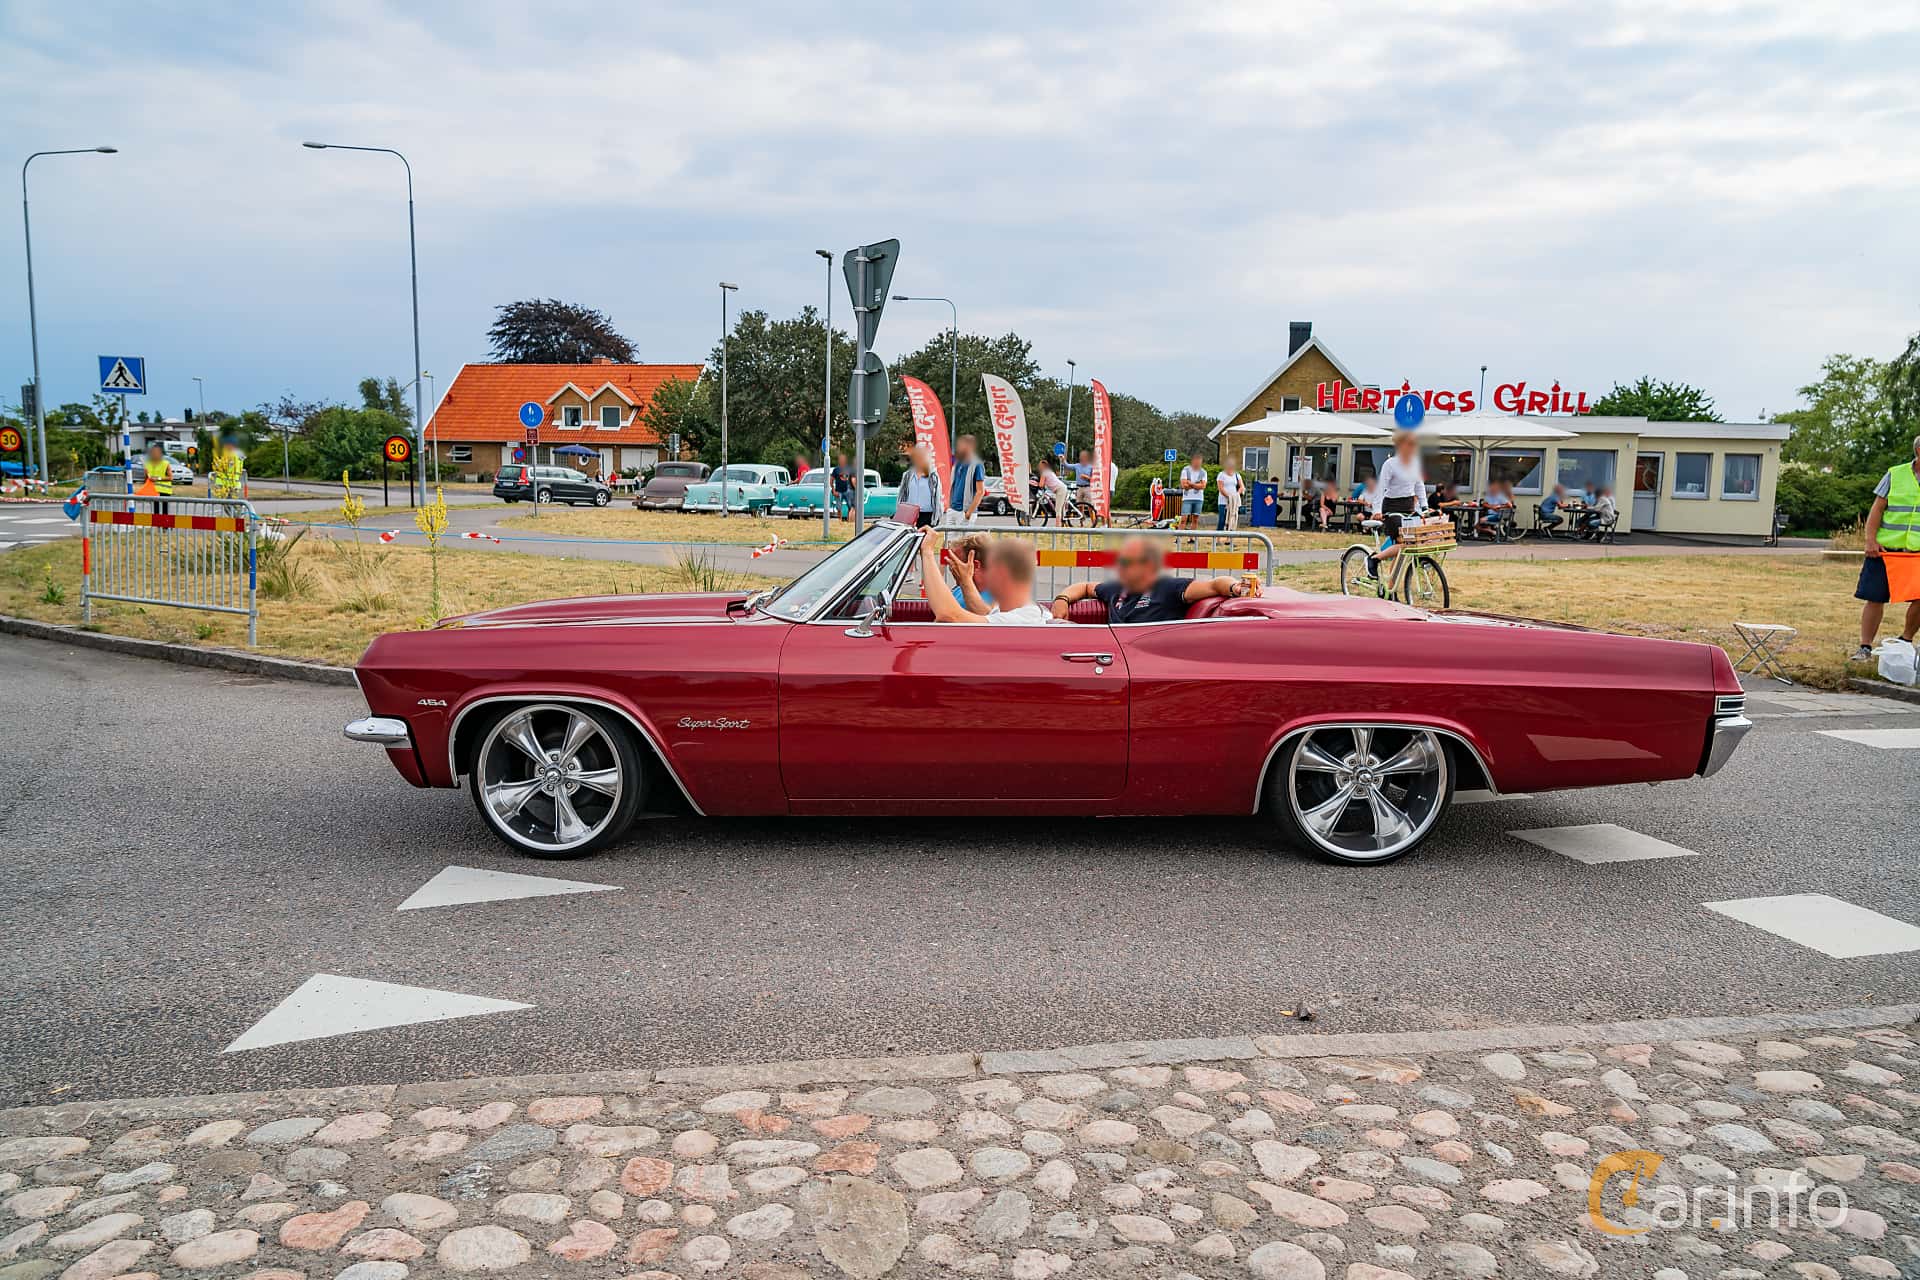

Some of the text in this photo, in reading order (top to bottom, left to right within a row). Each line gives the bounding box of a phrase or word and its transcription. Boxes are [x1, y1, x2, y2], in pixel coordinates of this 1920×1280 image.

[2, 434, 17, 446] 30
[390, 443, 406, 456] 30
[417, 698, 448, 707] 454
